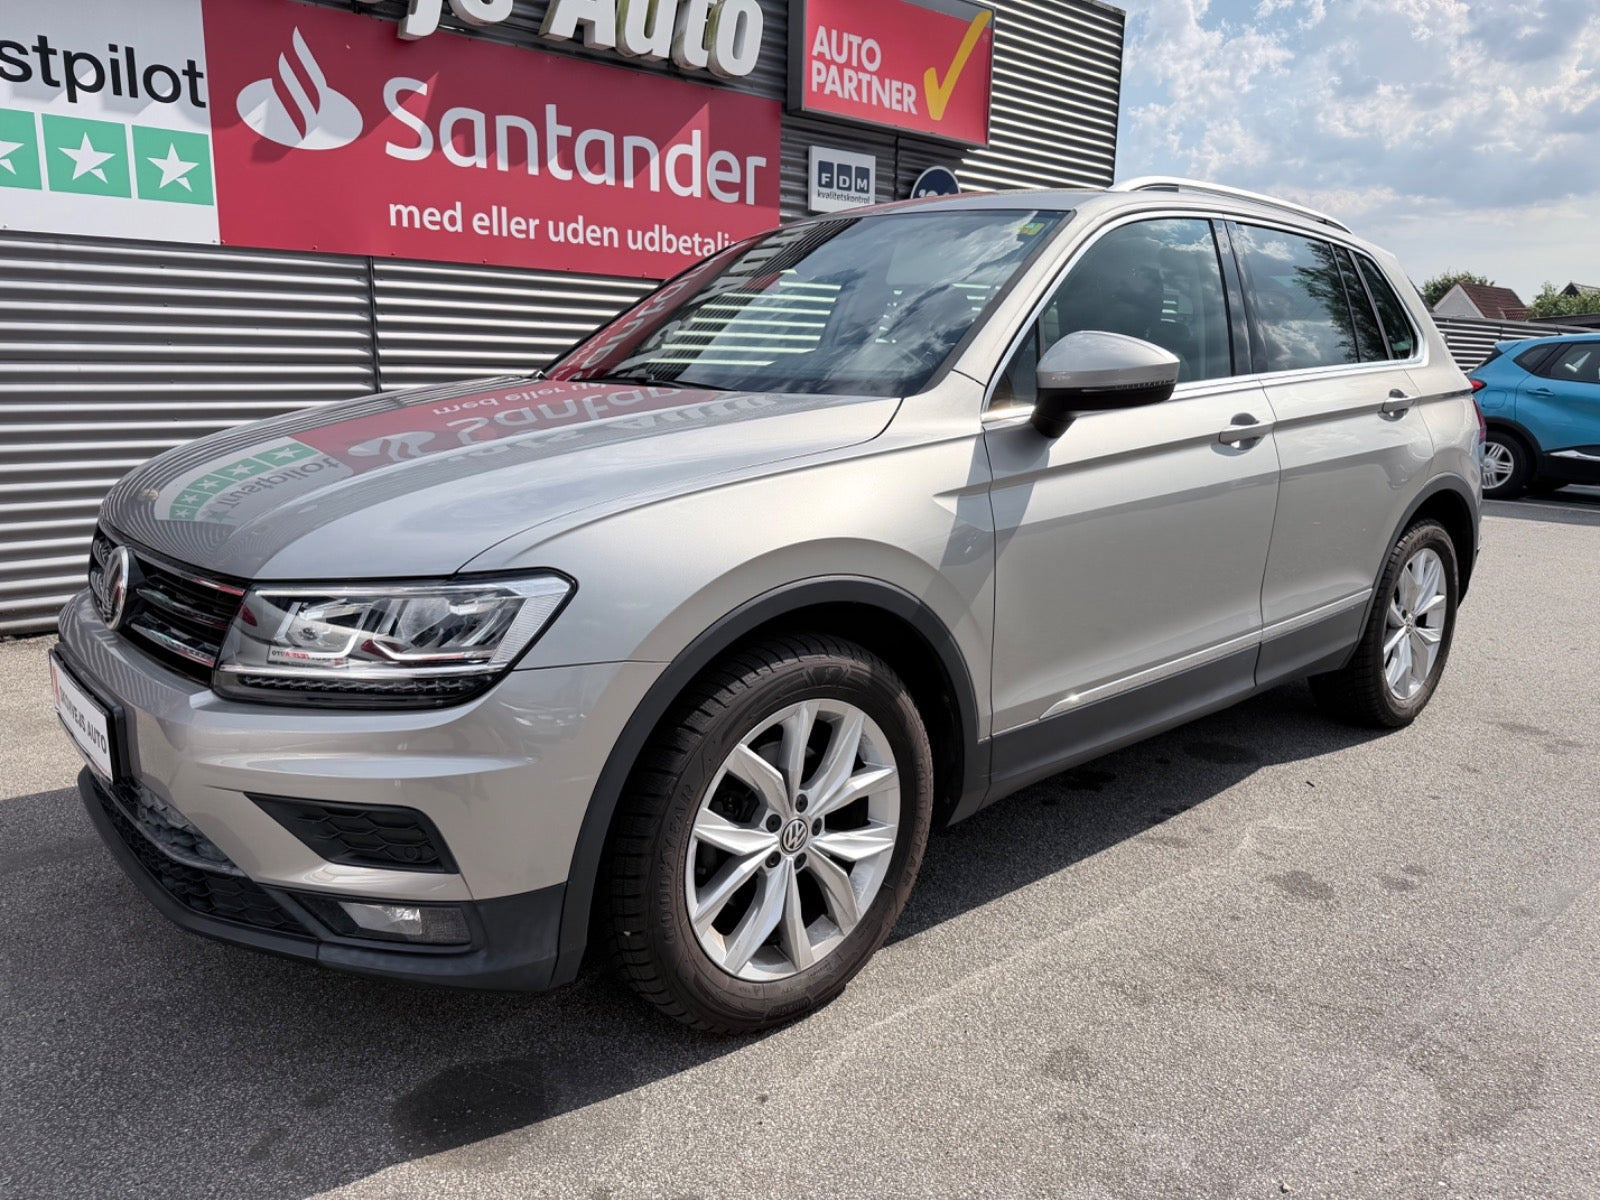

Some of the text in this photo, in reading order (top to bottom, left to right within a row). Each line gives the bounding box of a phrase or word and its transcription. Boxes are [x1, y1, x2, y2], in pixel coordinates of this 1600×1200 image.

[0, 35, 206, 108] stpilot
[812, 25, 881, 72] AUTO
[812, 60, 917, 115] PARTNER
[383, 77, 767, 205] Santander
[817, 189, 870, 204] kvalitetskontrol
[821, 173, 868, 191] FDM
[389, 201, 738, 257] med eller uden udbetali
